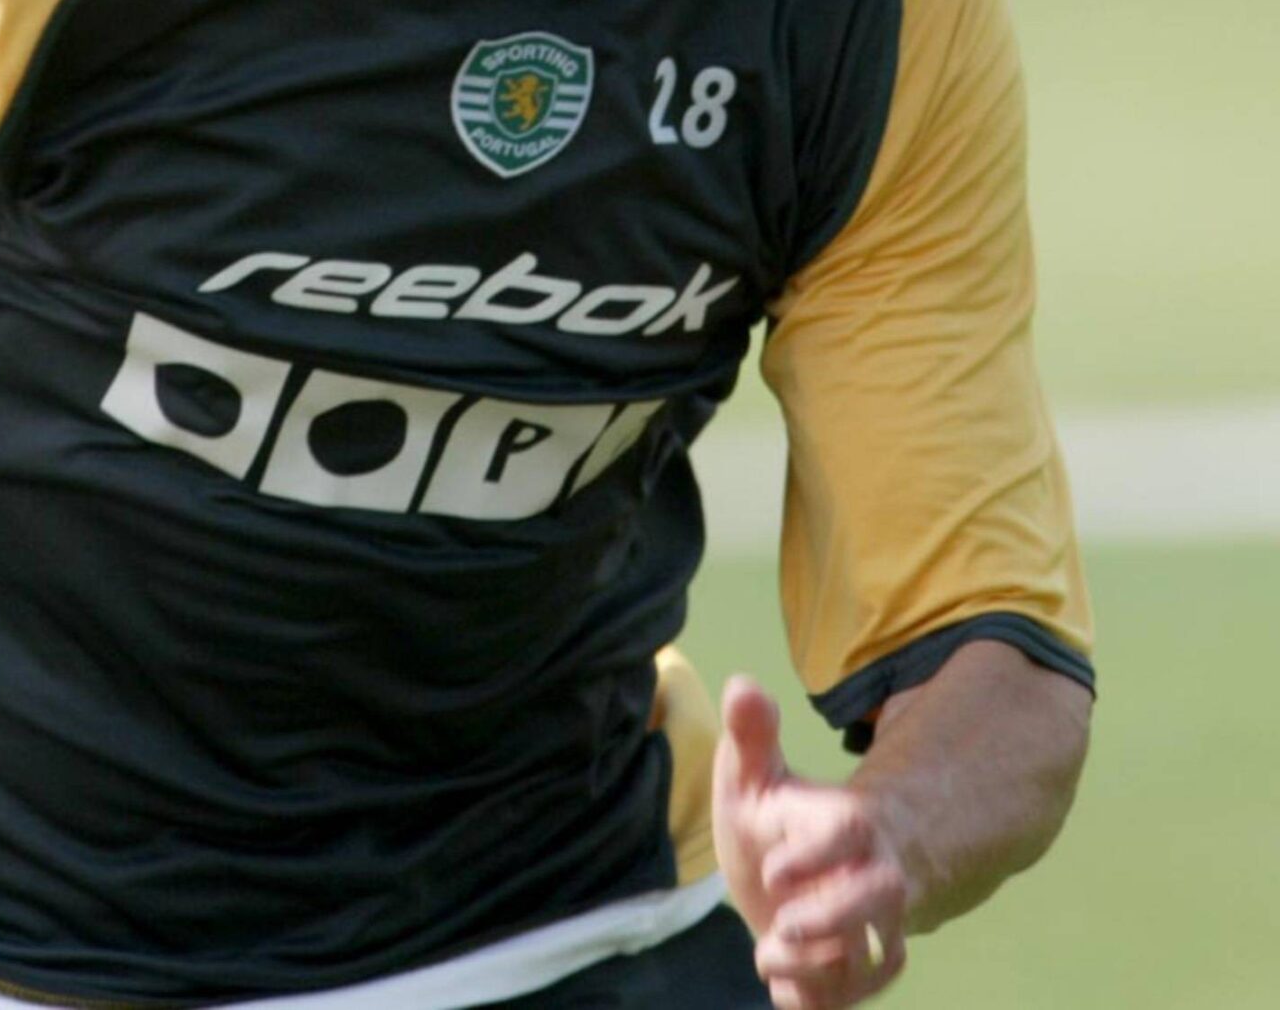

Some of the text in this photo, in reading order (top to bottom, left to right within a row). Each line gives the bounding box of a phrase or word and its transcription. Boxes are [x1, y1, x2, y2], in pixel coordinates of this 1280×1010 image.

[481, 44, 578, 77] SPORTING
[649, 56, 737, 149] 28
[470, 127, 563, 158] PORTUGAL
[198, 252, 738, 335] reebok
